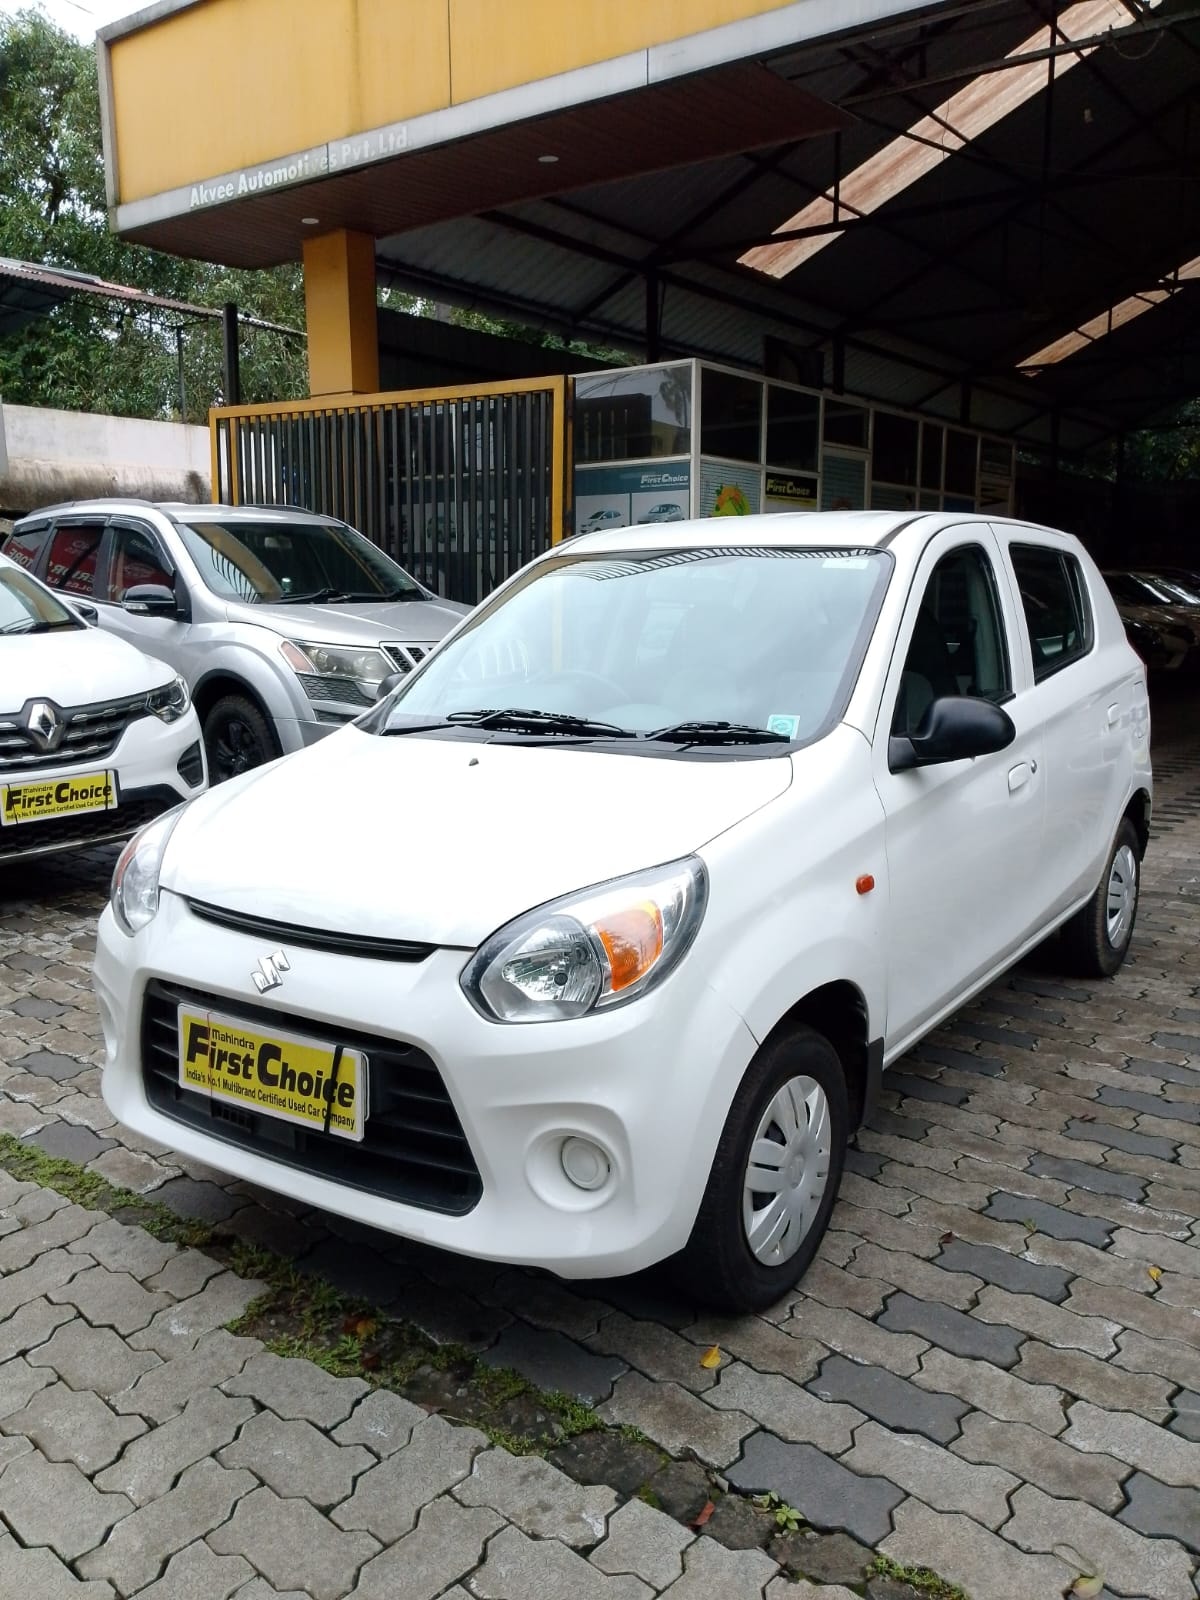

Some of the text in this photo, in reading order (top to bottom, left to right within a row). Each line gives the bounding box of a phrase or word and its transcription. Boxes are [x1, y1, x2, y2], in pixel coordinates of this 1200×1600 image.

[189, 182, 234, 208] Akvee
[211, 1028, 255, 1051] Mahindra
[186, 1067, 355, 1130] India's No.1 Multibrand Certified Used Car Cmpany
